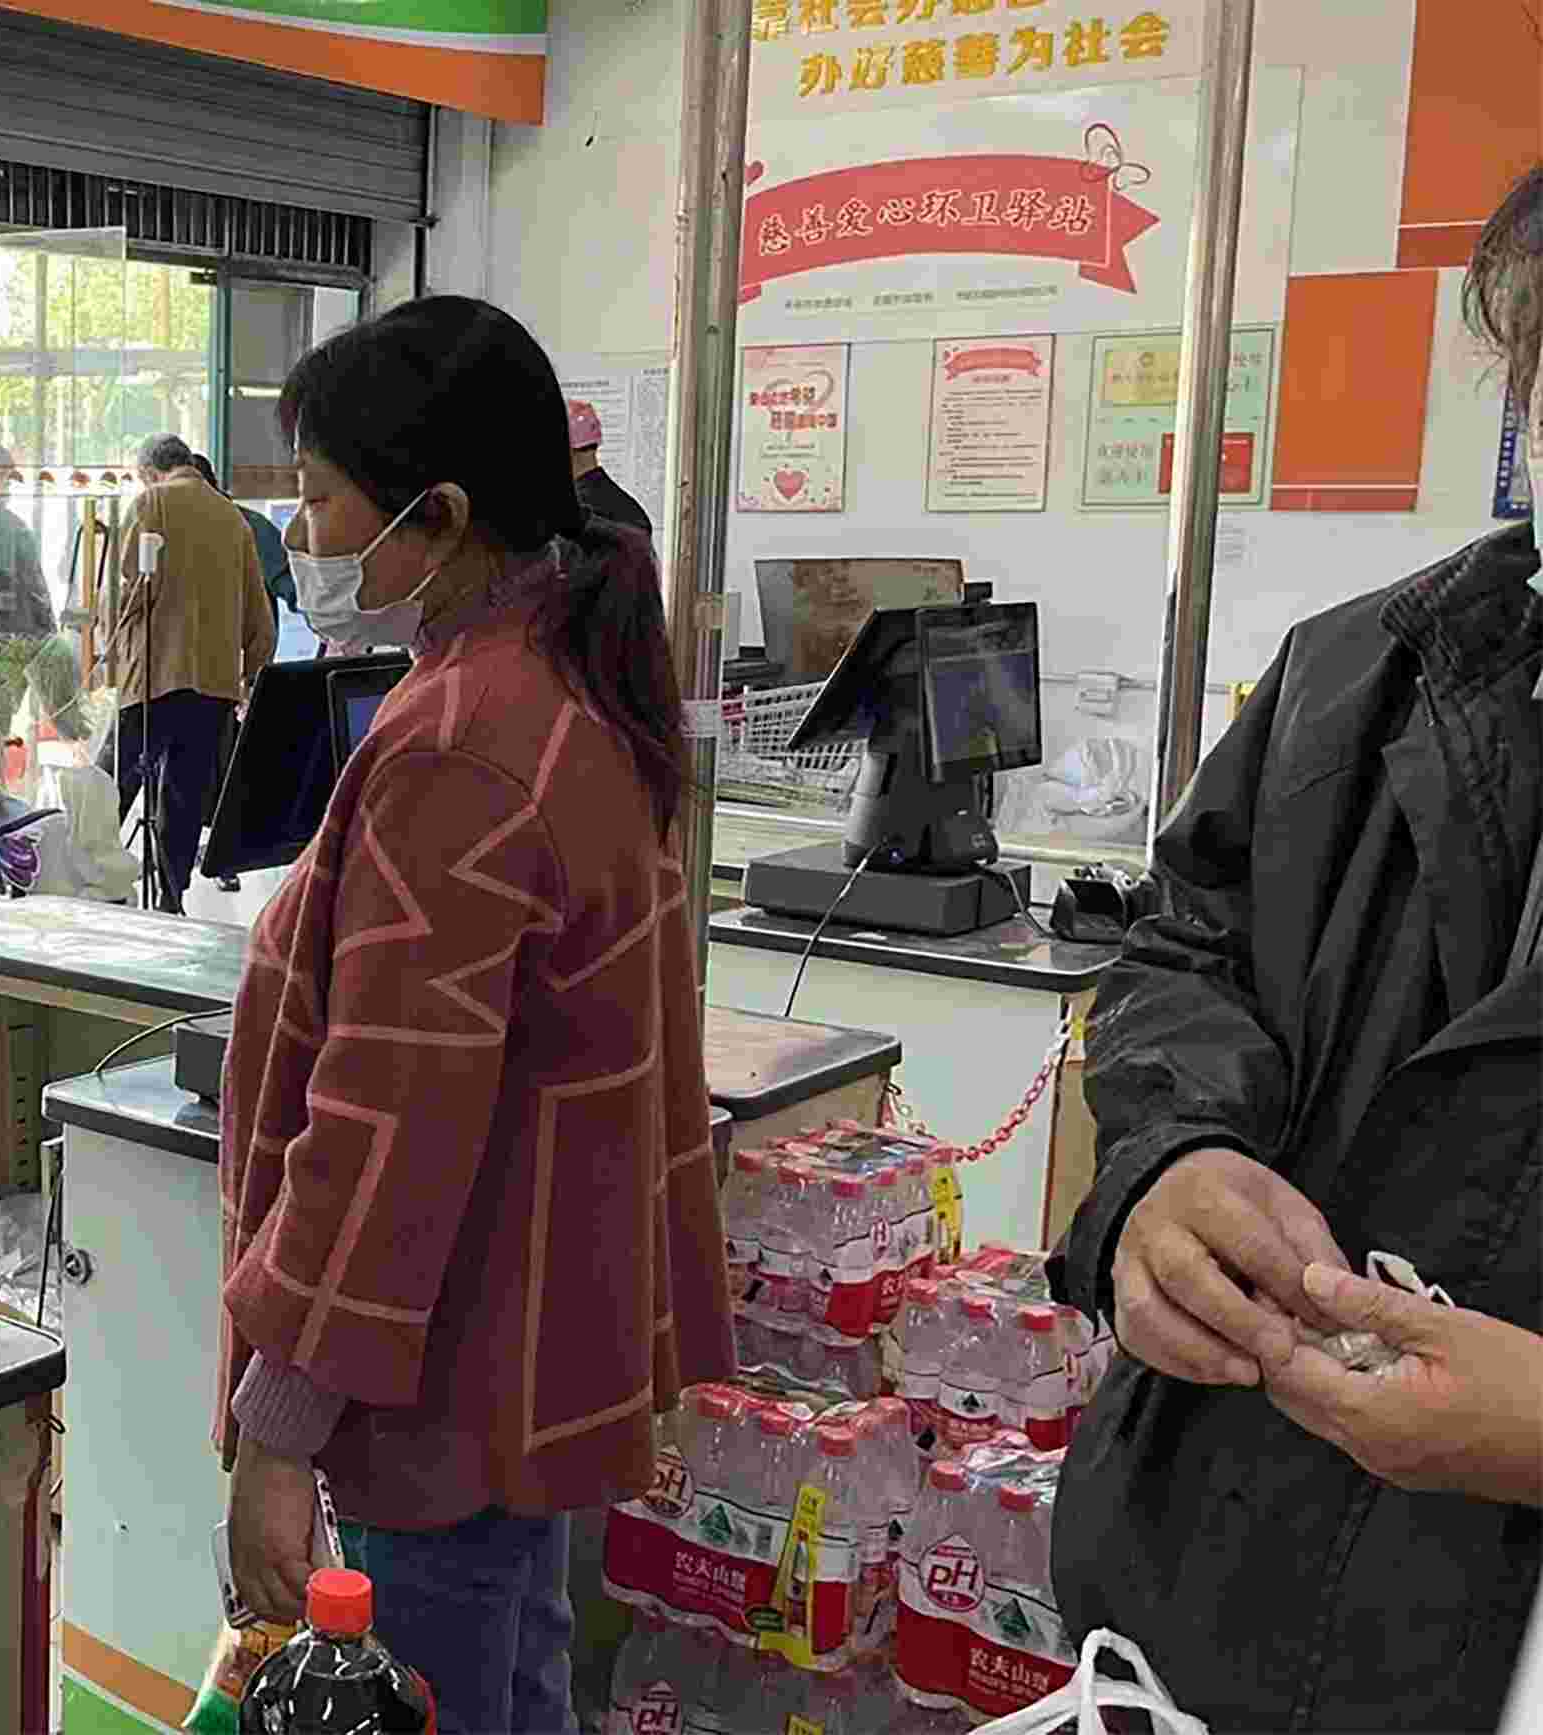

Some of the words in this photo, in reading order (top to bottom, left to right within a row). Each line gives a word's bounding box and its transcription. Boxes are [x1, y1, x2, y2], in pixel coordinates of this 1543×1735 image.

[757, 189, 1097, 256] 慈善爱心环卫驿站
[928, 1559, 979, 1592] pH
[636, 1703, 679, 1731] pH
